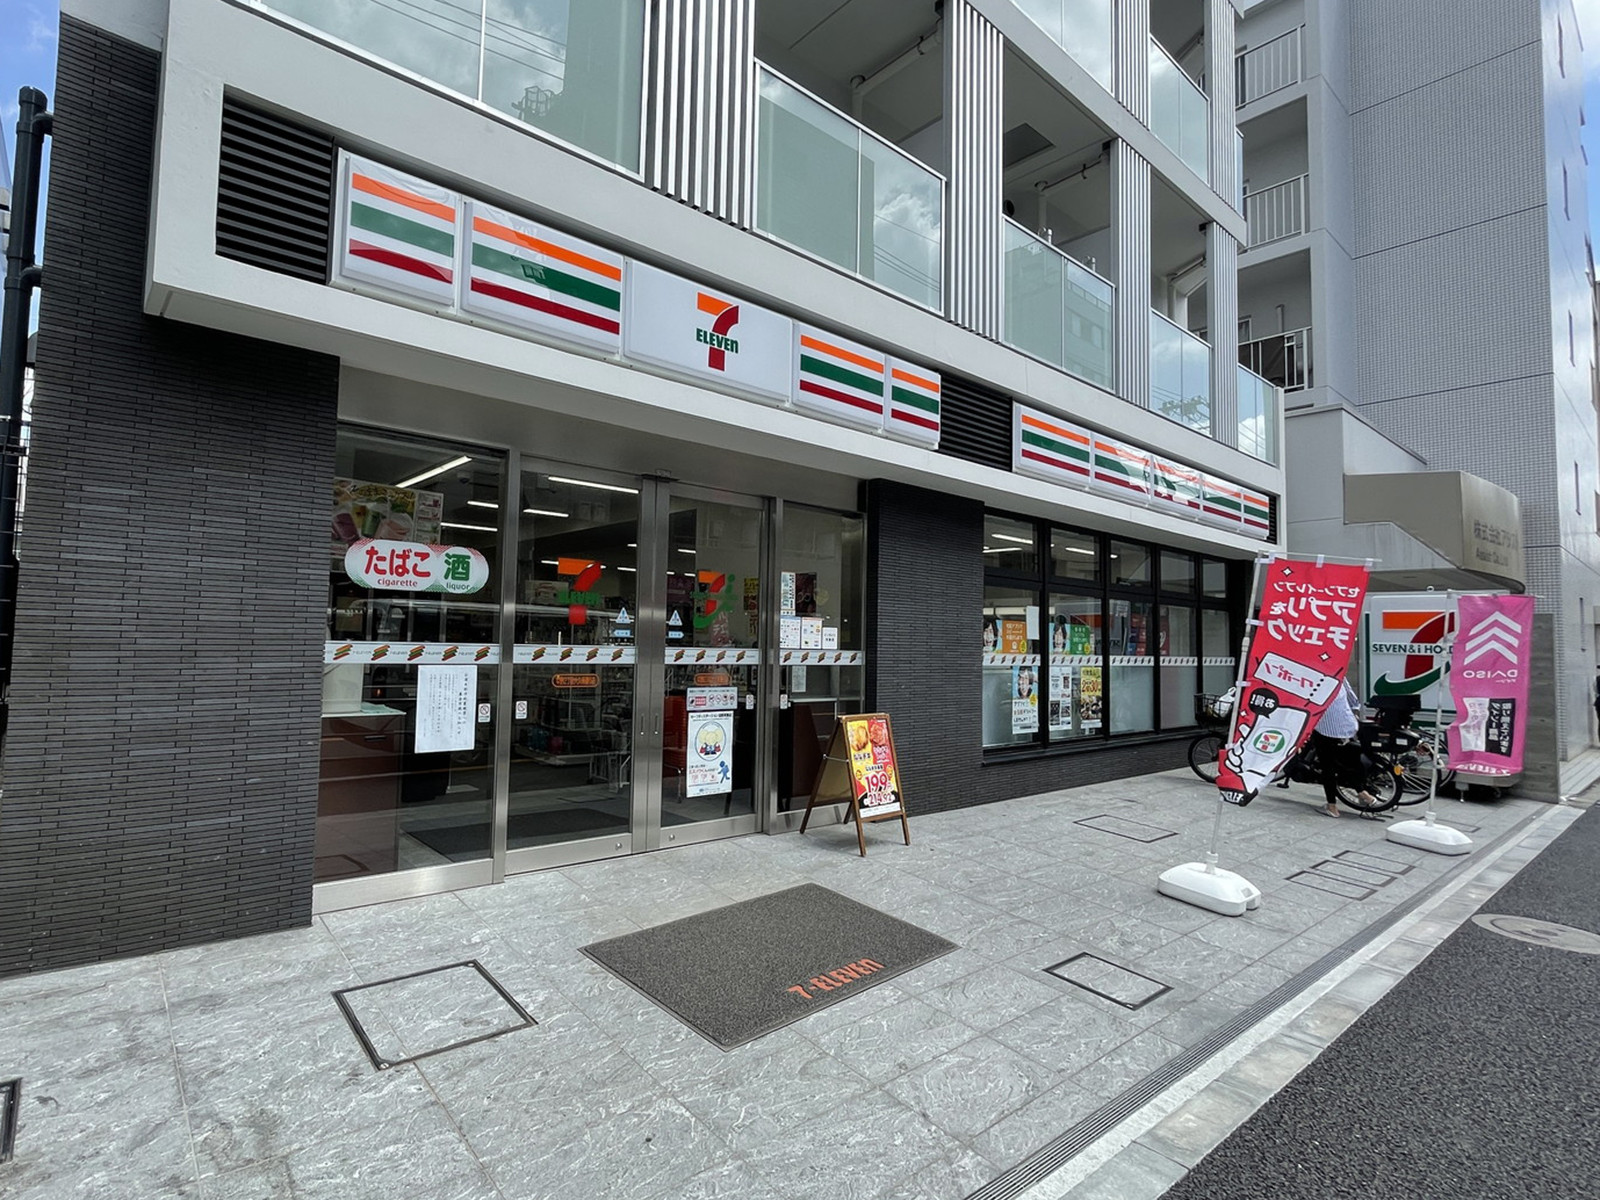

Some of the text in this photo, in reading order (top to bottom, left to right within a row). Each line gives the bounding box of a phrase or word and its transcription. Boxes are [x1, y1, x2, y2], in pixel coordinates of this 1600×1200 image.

[364, 545, 471, 582] たばこ 酒
[377, 577, 471, 591] cigarette liquor
[1372, 643, 1454, 654] SEVEN&i HOD
